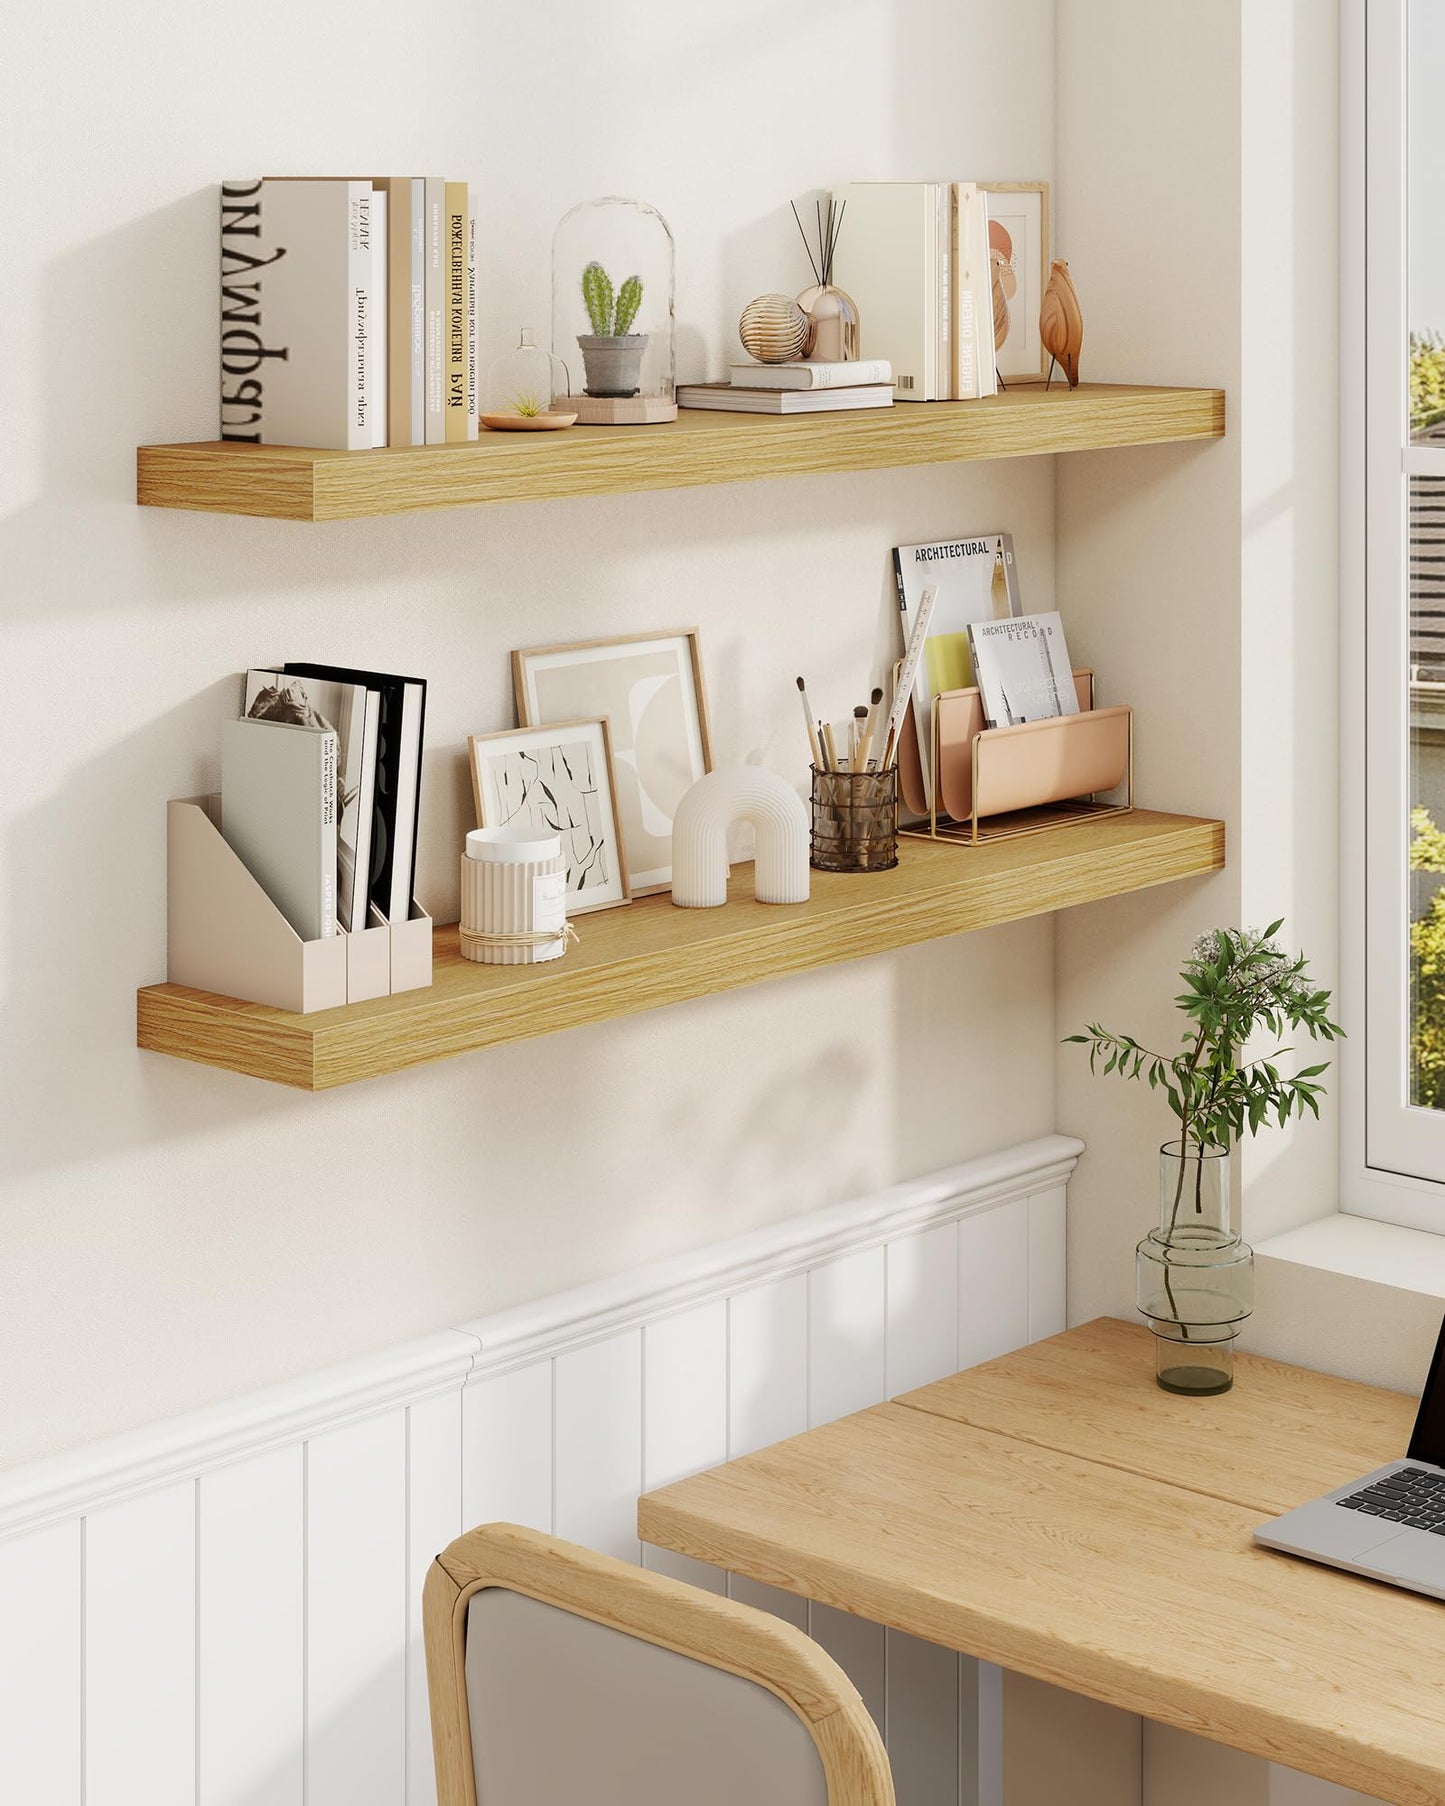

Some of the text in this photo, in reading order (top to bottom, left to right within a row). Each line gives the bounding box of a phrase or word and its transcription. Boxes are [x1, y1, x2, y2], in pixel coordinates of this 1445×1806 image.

[914, 541, 989, 562] ARCHITECTURAL
[982, 620, 1035, 637] ARCHITECTURAL
[1007, 627, 1053, 642] RECORD
